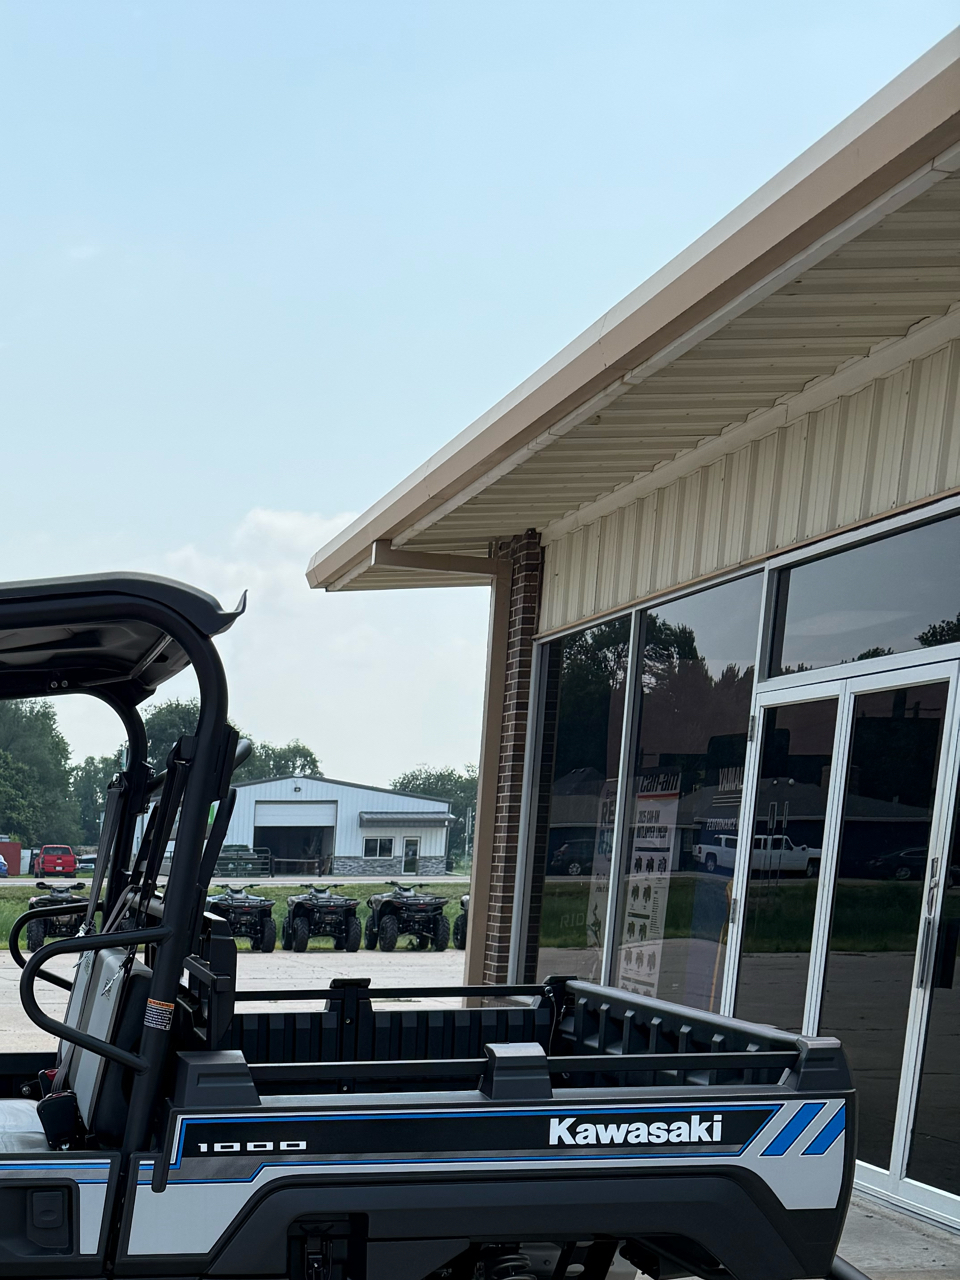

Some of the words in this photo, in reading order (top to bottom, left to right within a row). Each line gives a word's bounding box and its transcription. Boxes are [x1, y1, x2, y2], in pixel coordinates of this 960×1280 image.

[640, 773, 680, 793] can-am
[706, 817, 737, 831] PERFORMANCE
[548, 1114, 722, 1146] Kawasaki
[198, 1140, 307, 1152] 1000
